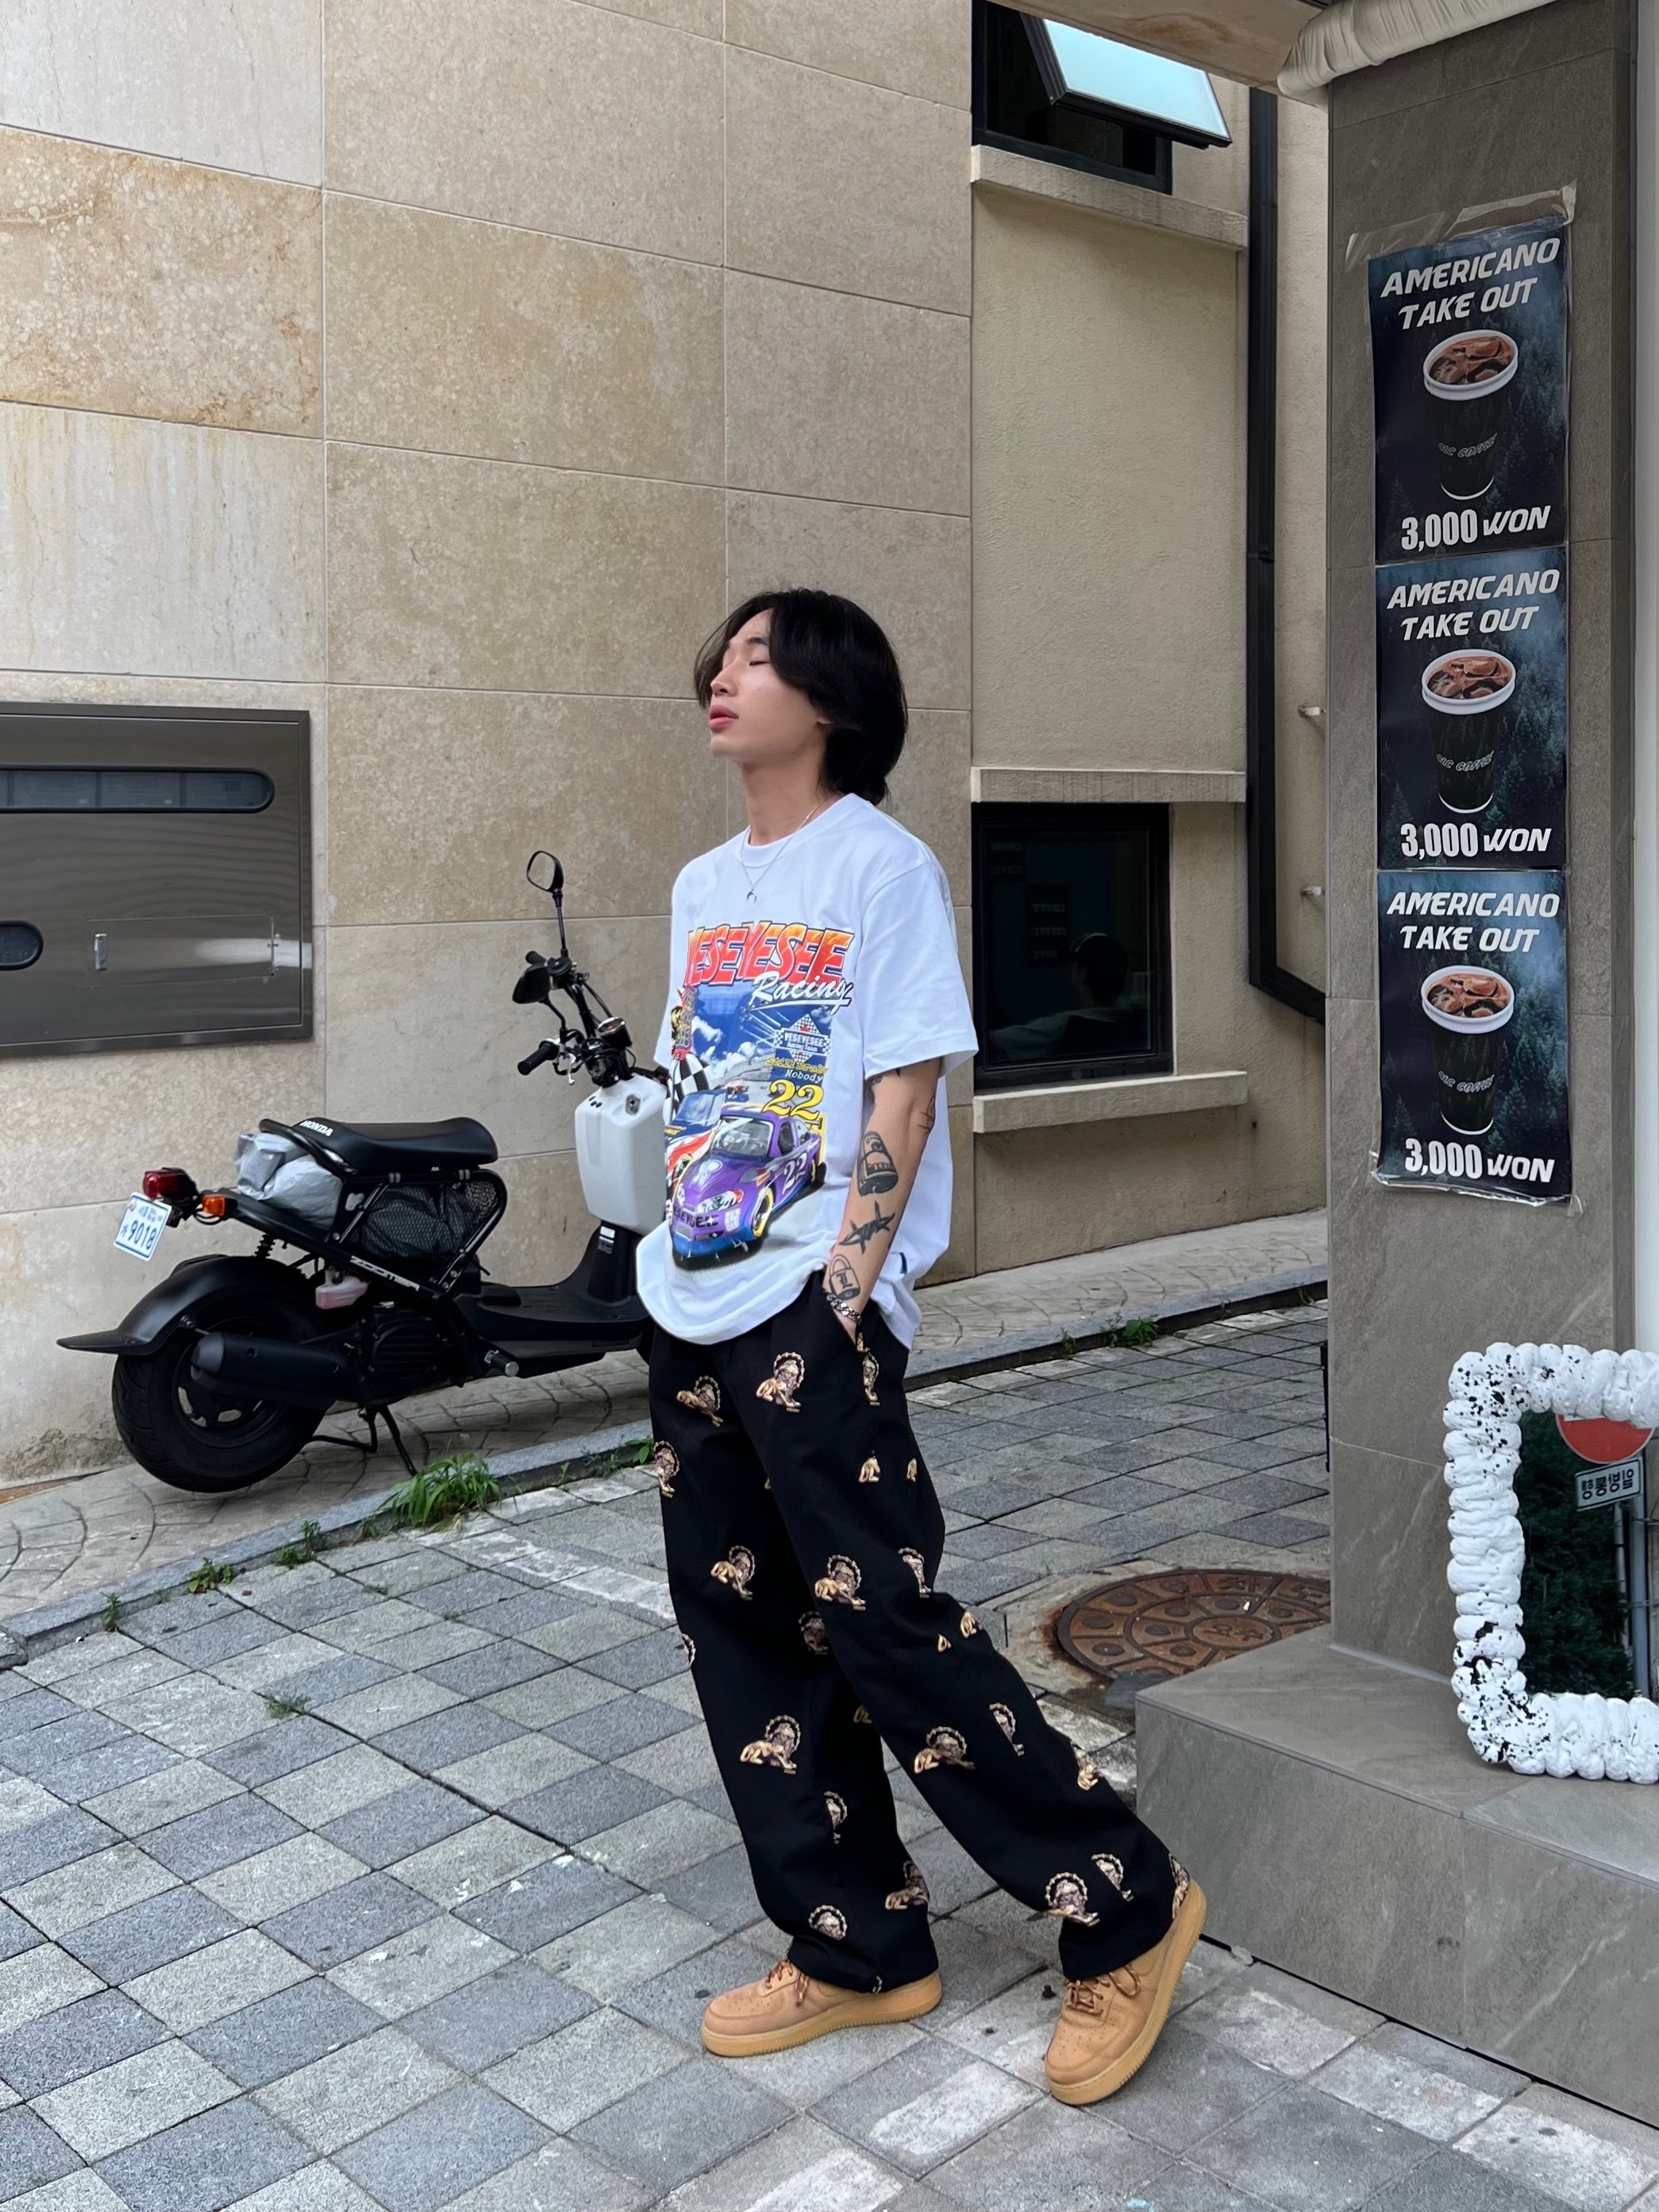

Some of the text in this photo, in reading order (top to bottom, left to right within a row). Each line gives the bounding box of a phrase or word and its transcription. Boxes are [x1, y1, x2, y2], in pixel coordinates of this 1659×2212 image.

[1380, 238, 1561, 298] AMERICANO
[1398, 278, 1538, 329] TAKE OUT
[1401, 506, 1552, 552] 3,000 WON
[1387, 569, 1560, 610] AMERICANO
[1401, 606, 1540, 641] TAKE OUT
[1400, 823, 1552, 860] 3,000 WON
[1387, 892, 1560, 918] AMERICANO
[1400, 925, 1540, 953] TAKE OUT
[749, 970, 854, 1016] Racing
[784, 1069, 824, 1084] Nobody
[762, 1079, 824, 1121] 22
[299, 1119, 333, 1136] HONDA
[782, 1152, 807, 1195] 22
[1404, 1138, 1555, 1183] 3,000 WON
[128, 1220, 157, 1250] 9018
